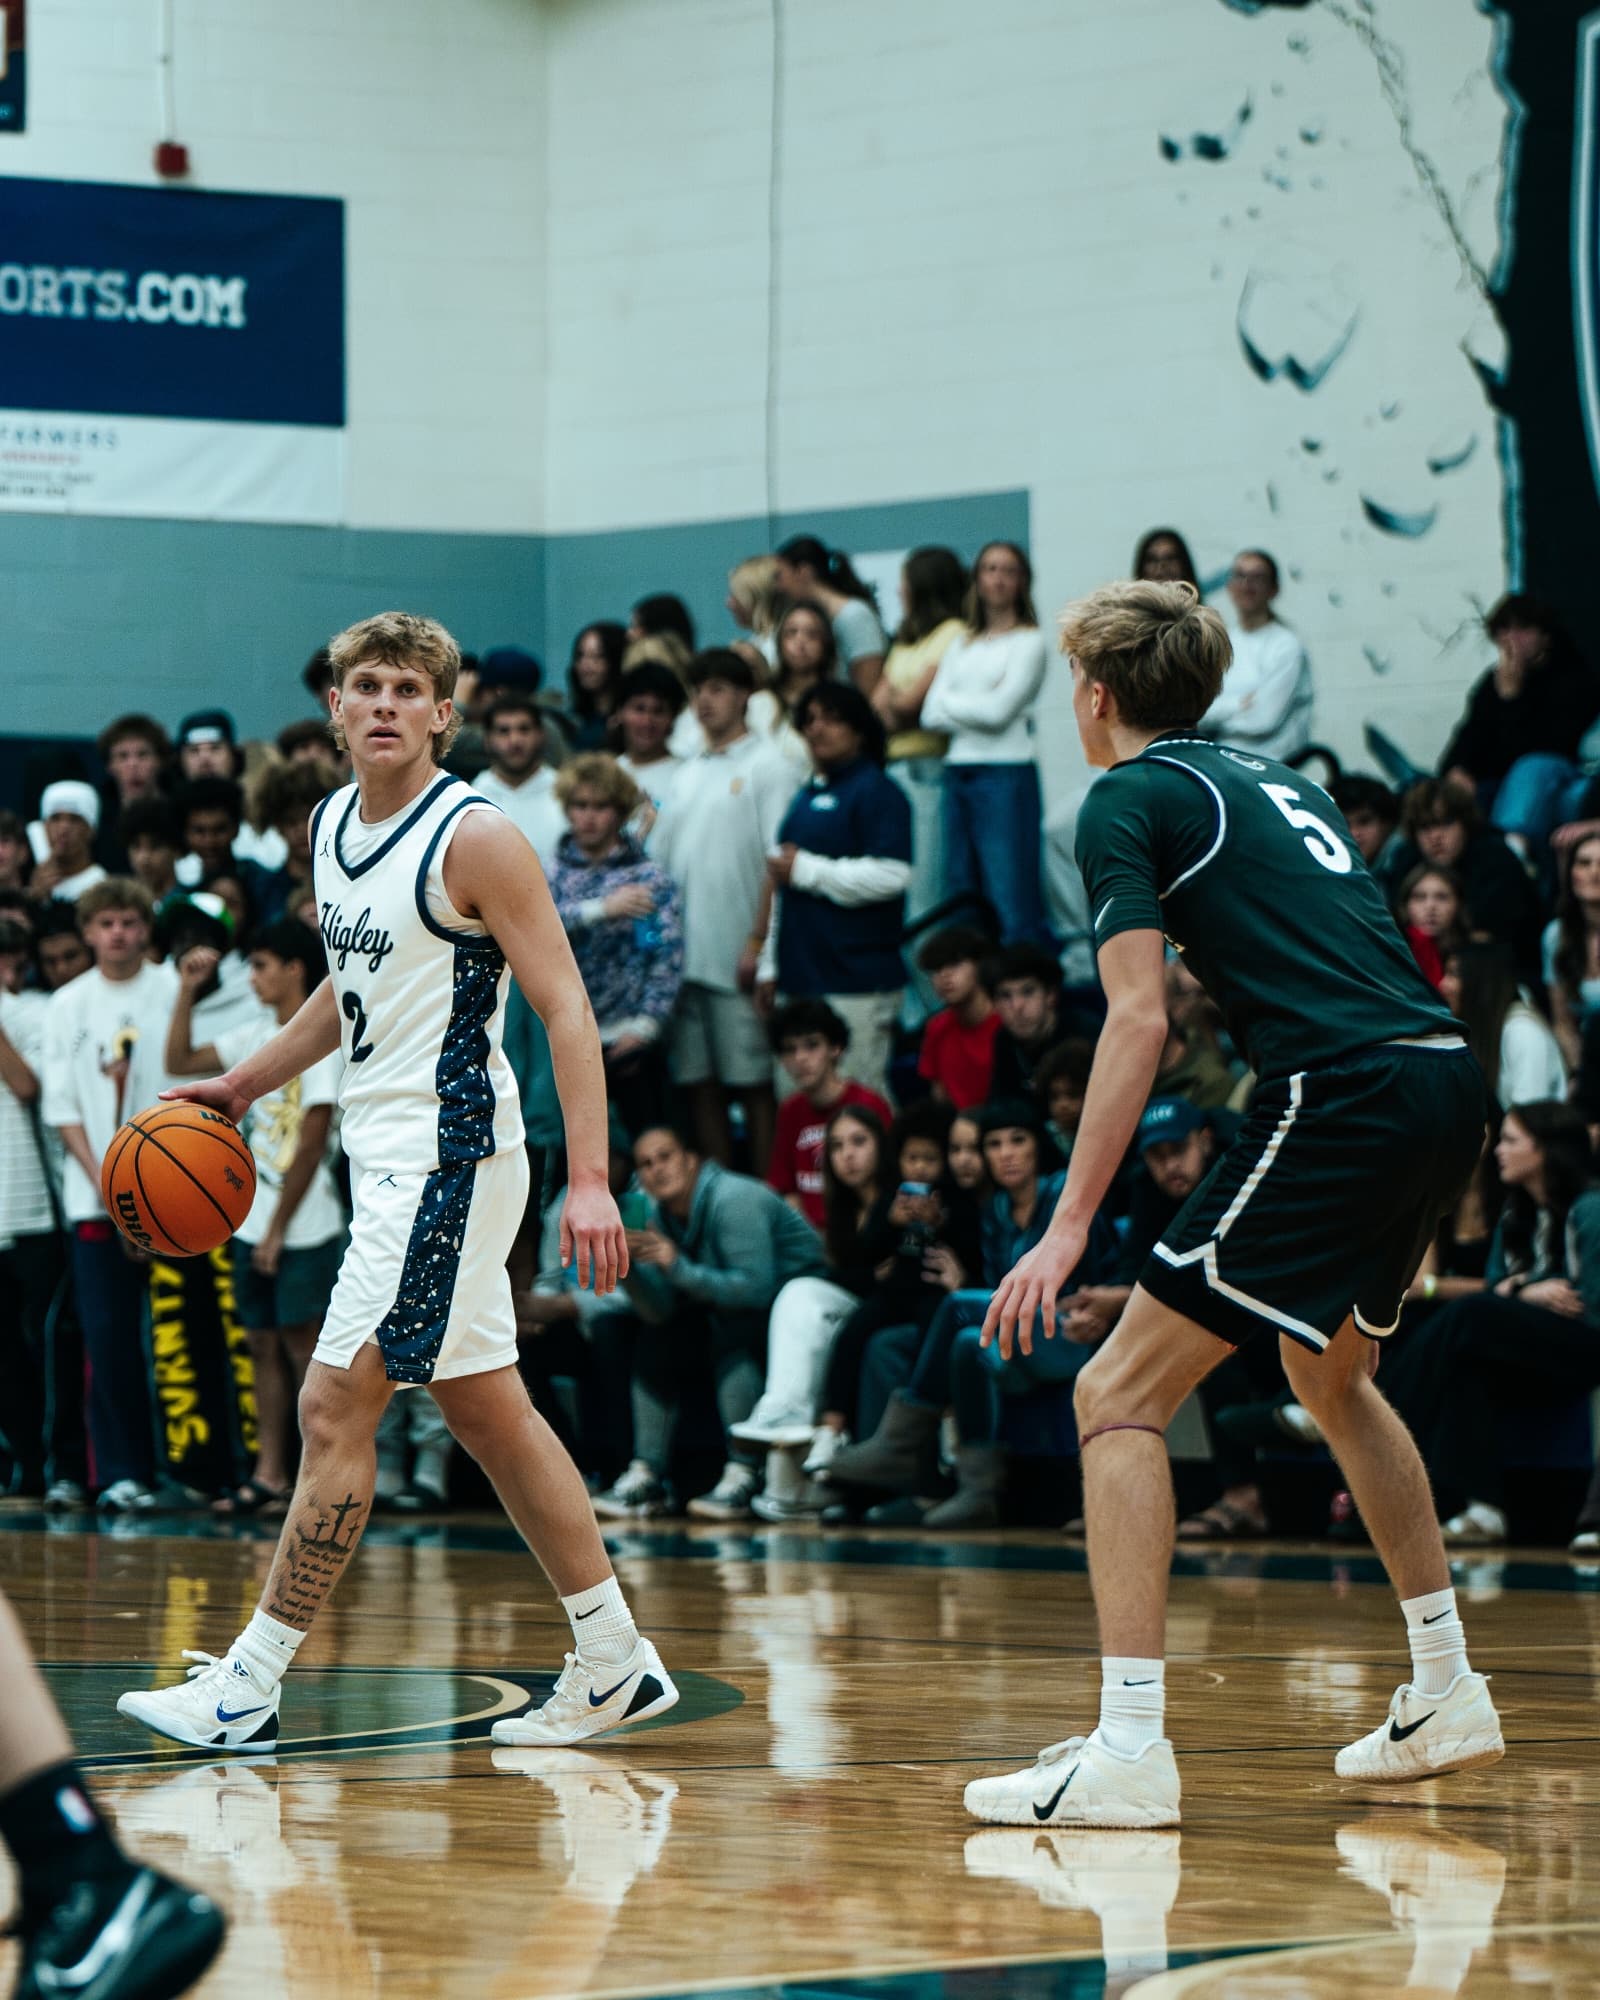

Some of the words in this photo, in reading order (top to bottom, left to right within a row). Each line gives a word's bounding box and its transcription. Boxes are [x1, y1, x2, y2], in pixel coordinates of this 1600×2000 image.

[0, 264, 245, 328] ORTS.COM
[1258, 782, 1352, 873] 5
[320, 902, 394, 973] Higley
[342, 990, 374, 1062] 2
